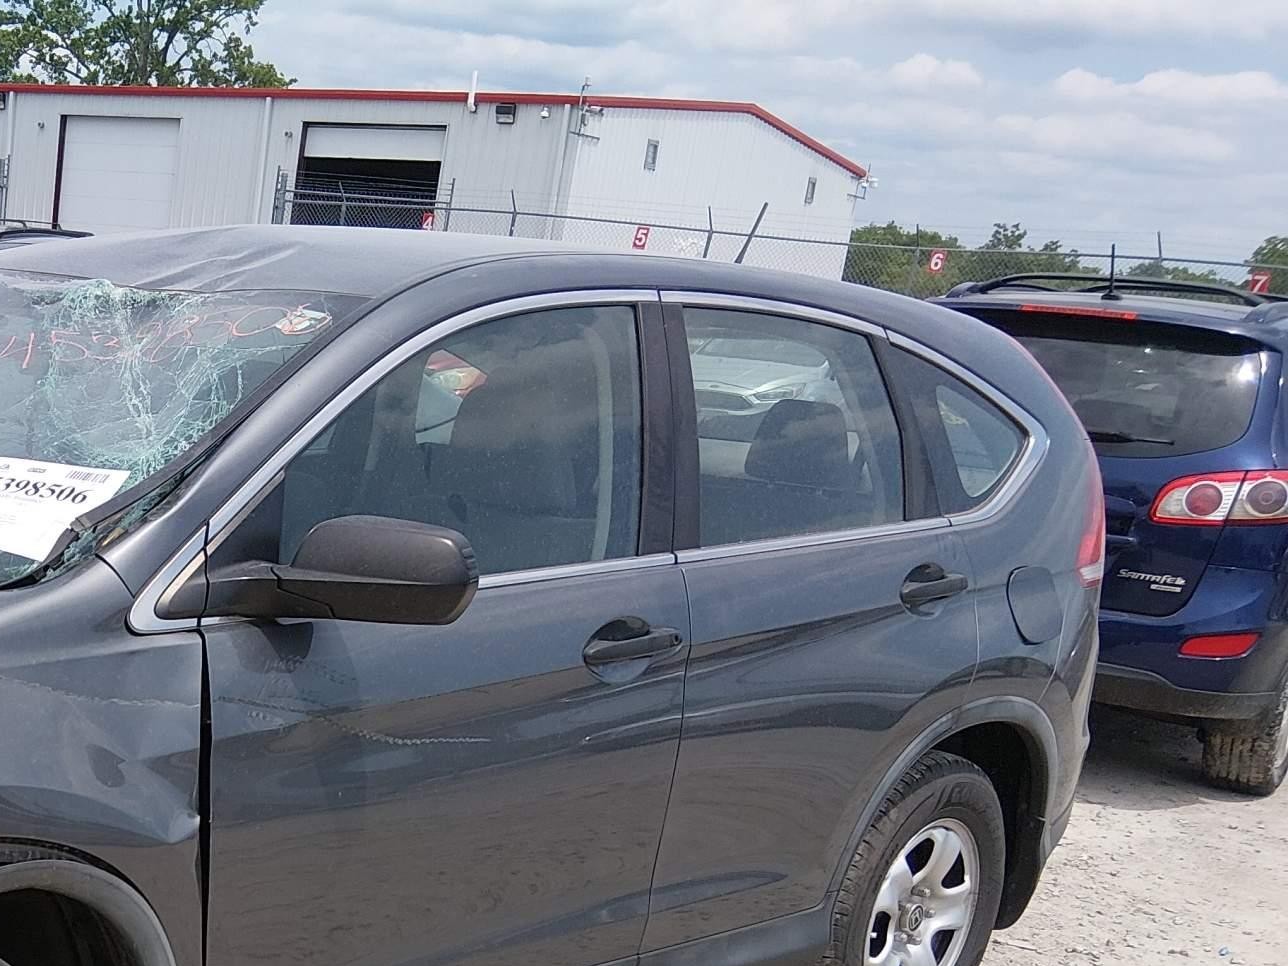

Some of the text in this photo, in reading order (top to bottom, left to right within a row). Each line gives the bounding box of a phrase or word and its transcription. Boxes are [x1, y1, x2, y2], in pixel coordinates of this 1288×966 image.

[423, 215, 433, 231] 4
[635, 228, 648, 246] 5
[930, 253, 944, 271] 6
[1252, 274, 1269, 294] 7
